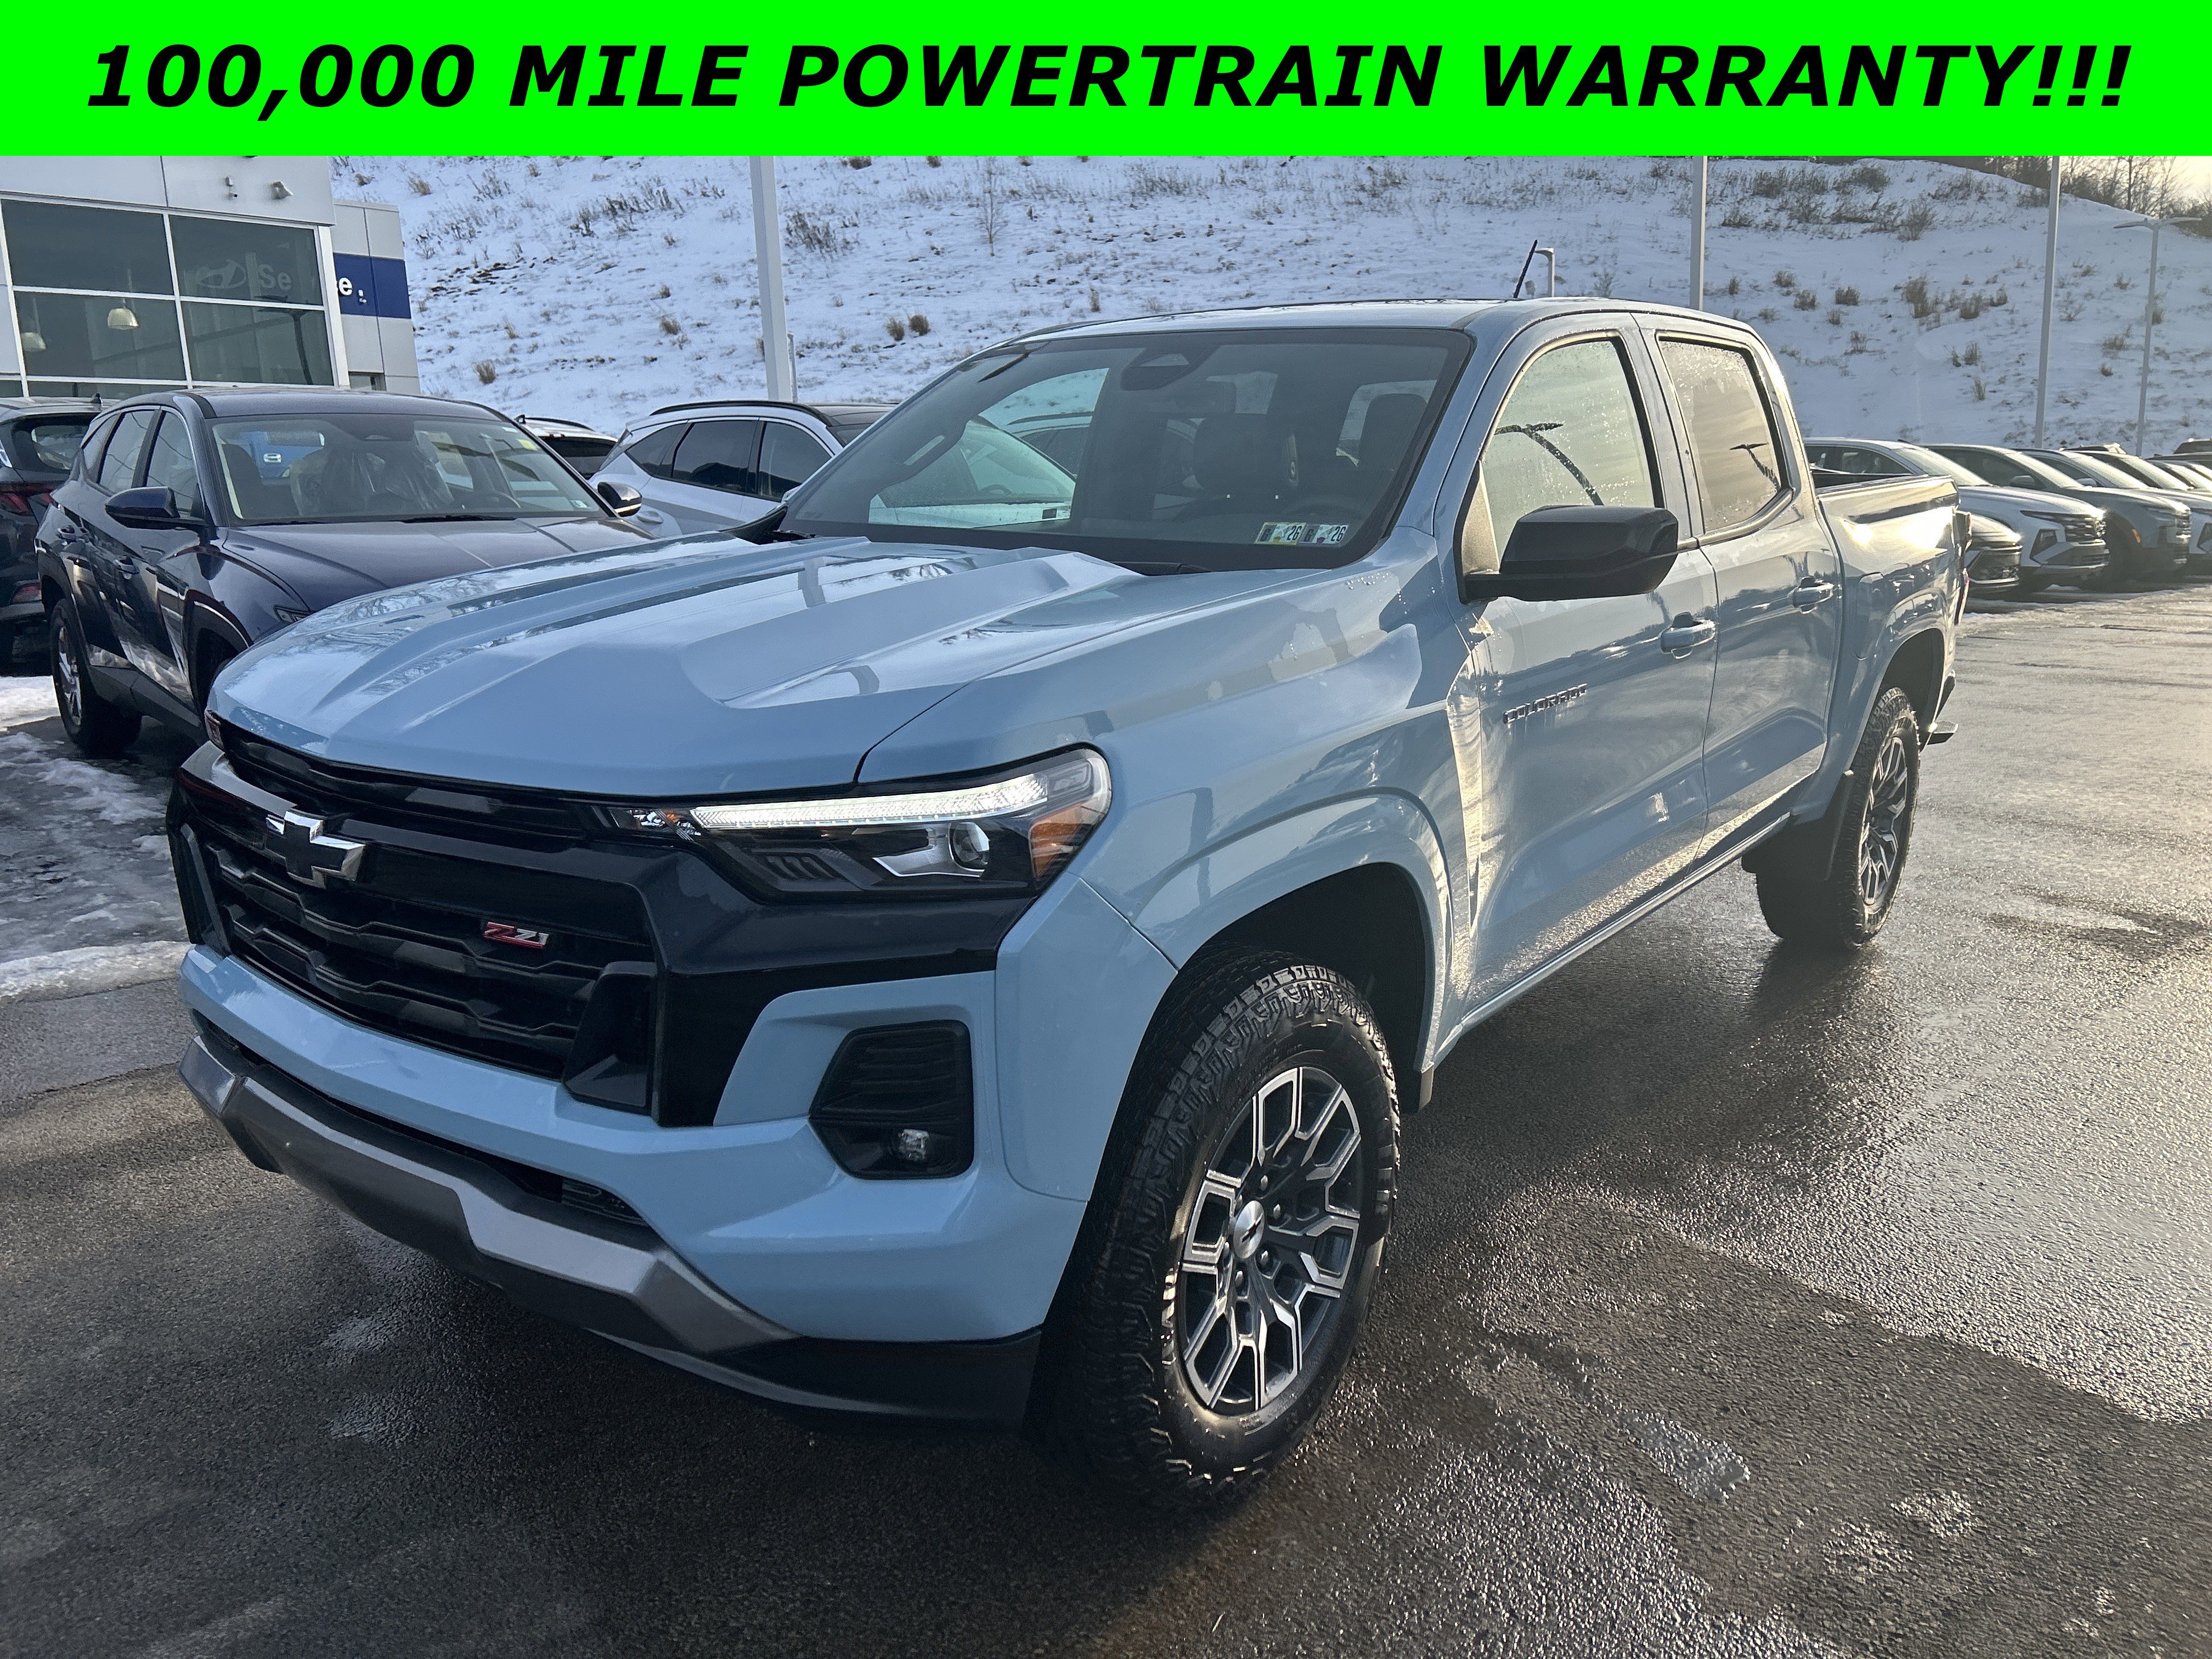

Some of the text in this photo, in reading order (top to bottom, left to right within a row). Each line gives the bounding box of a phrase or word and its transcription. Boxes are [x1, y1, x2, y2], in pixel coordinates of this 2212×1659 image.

[1286, 525, 1303, 541] 26
[1330, 526, 1347, 542] 26
[484, 922, 550, 949] Z71
